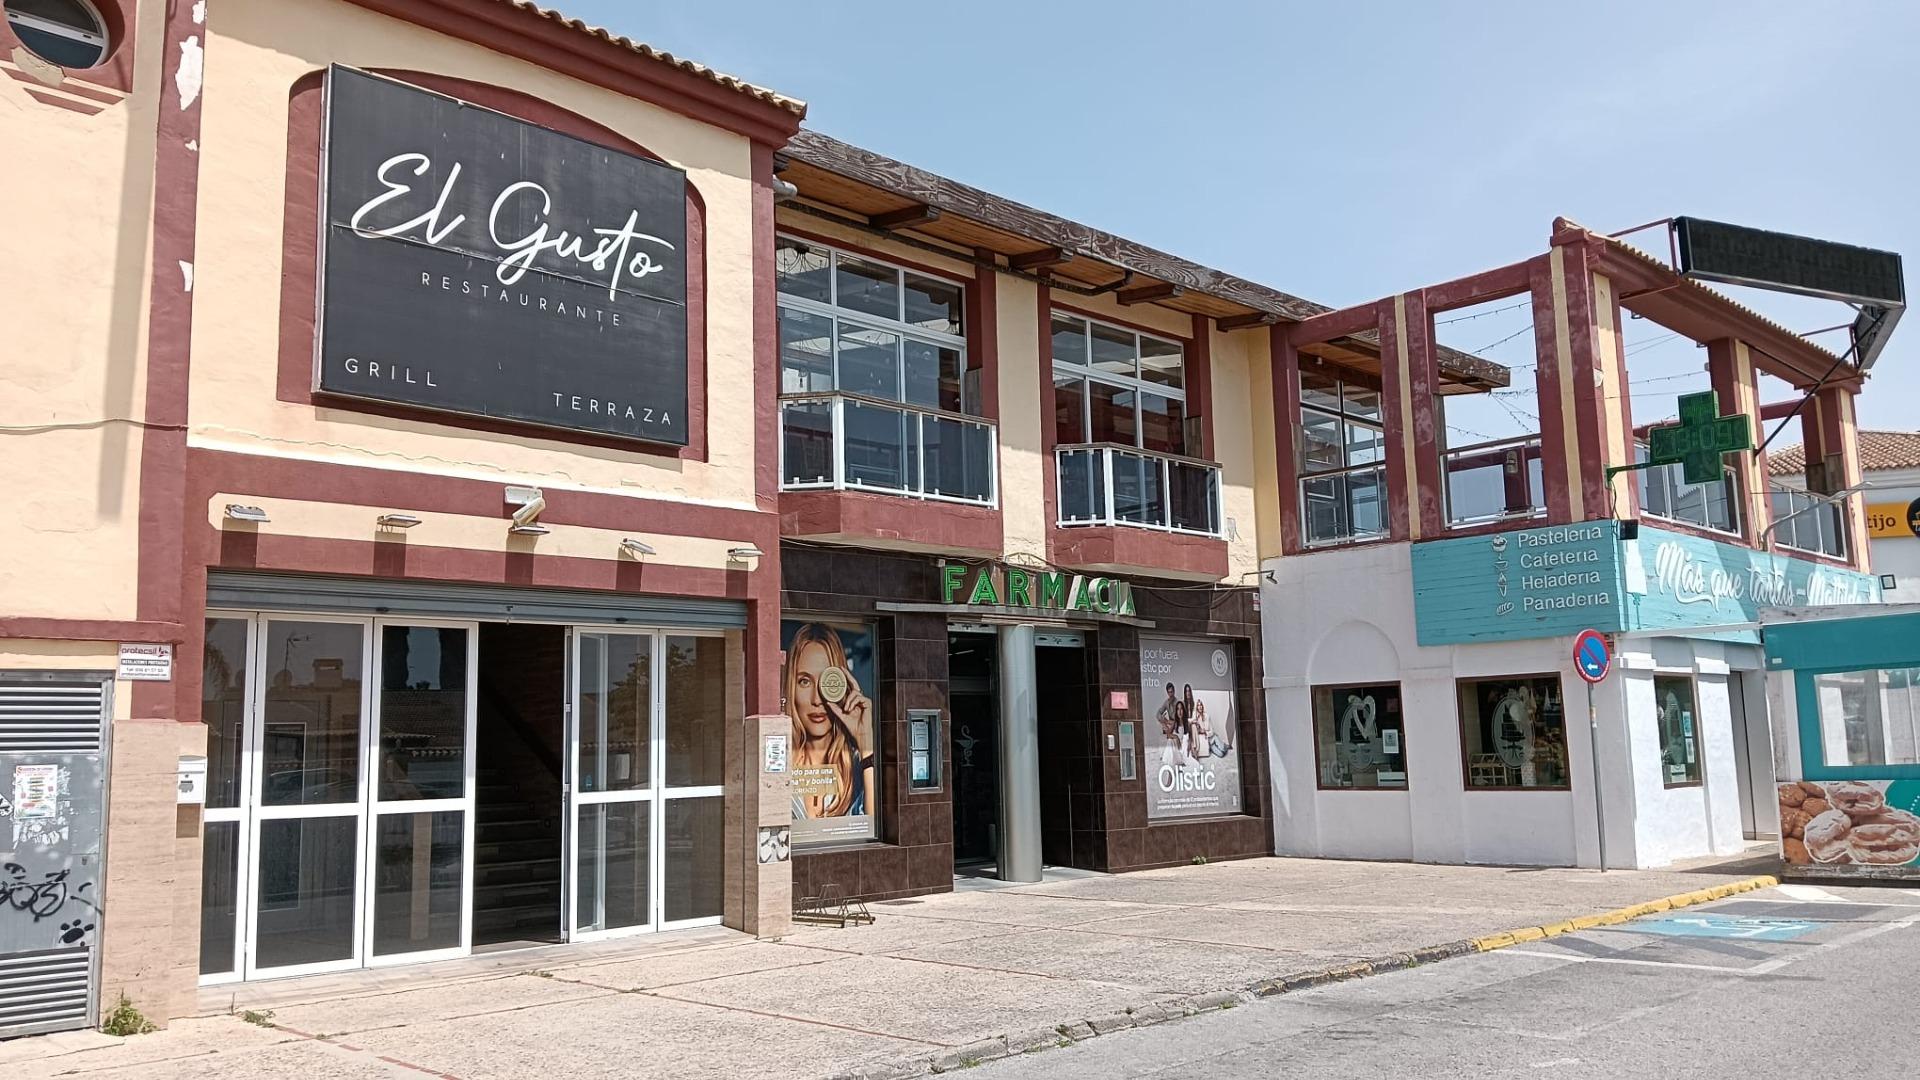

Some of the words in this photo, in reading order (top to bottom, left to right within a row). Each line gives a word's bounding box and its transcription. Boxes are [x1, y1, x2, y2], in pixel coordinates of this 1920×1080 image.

[351, 152, 466, 245] El
[489, 181, 676, 301] Gusto
[421, 271, 620, 327] RESTAURANTE
[344, 357, 438, 388] GRILL
[552, 392, 672, 426] TERRAZA
[943, 564, 1137, 616] FARMACIA
[1710, 568, 1745, 613] que
[1158, 664, 1172, 675] por
